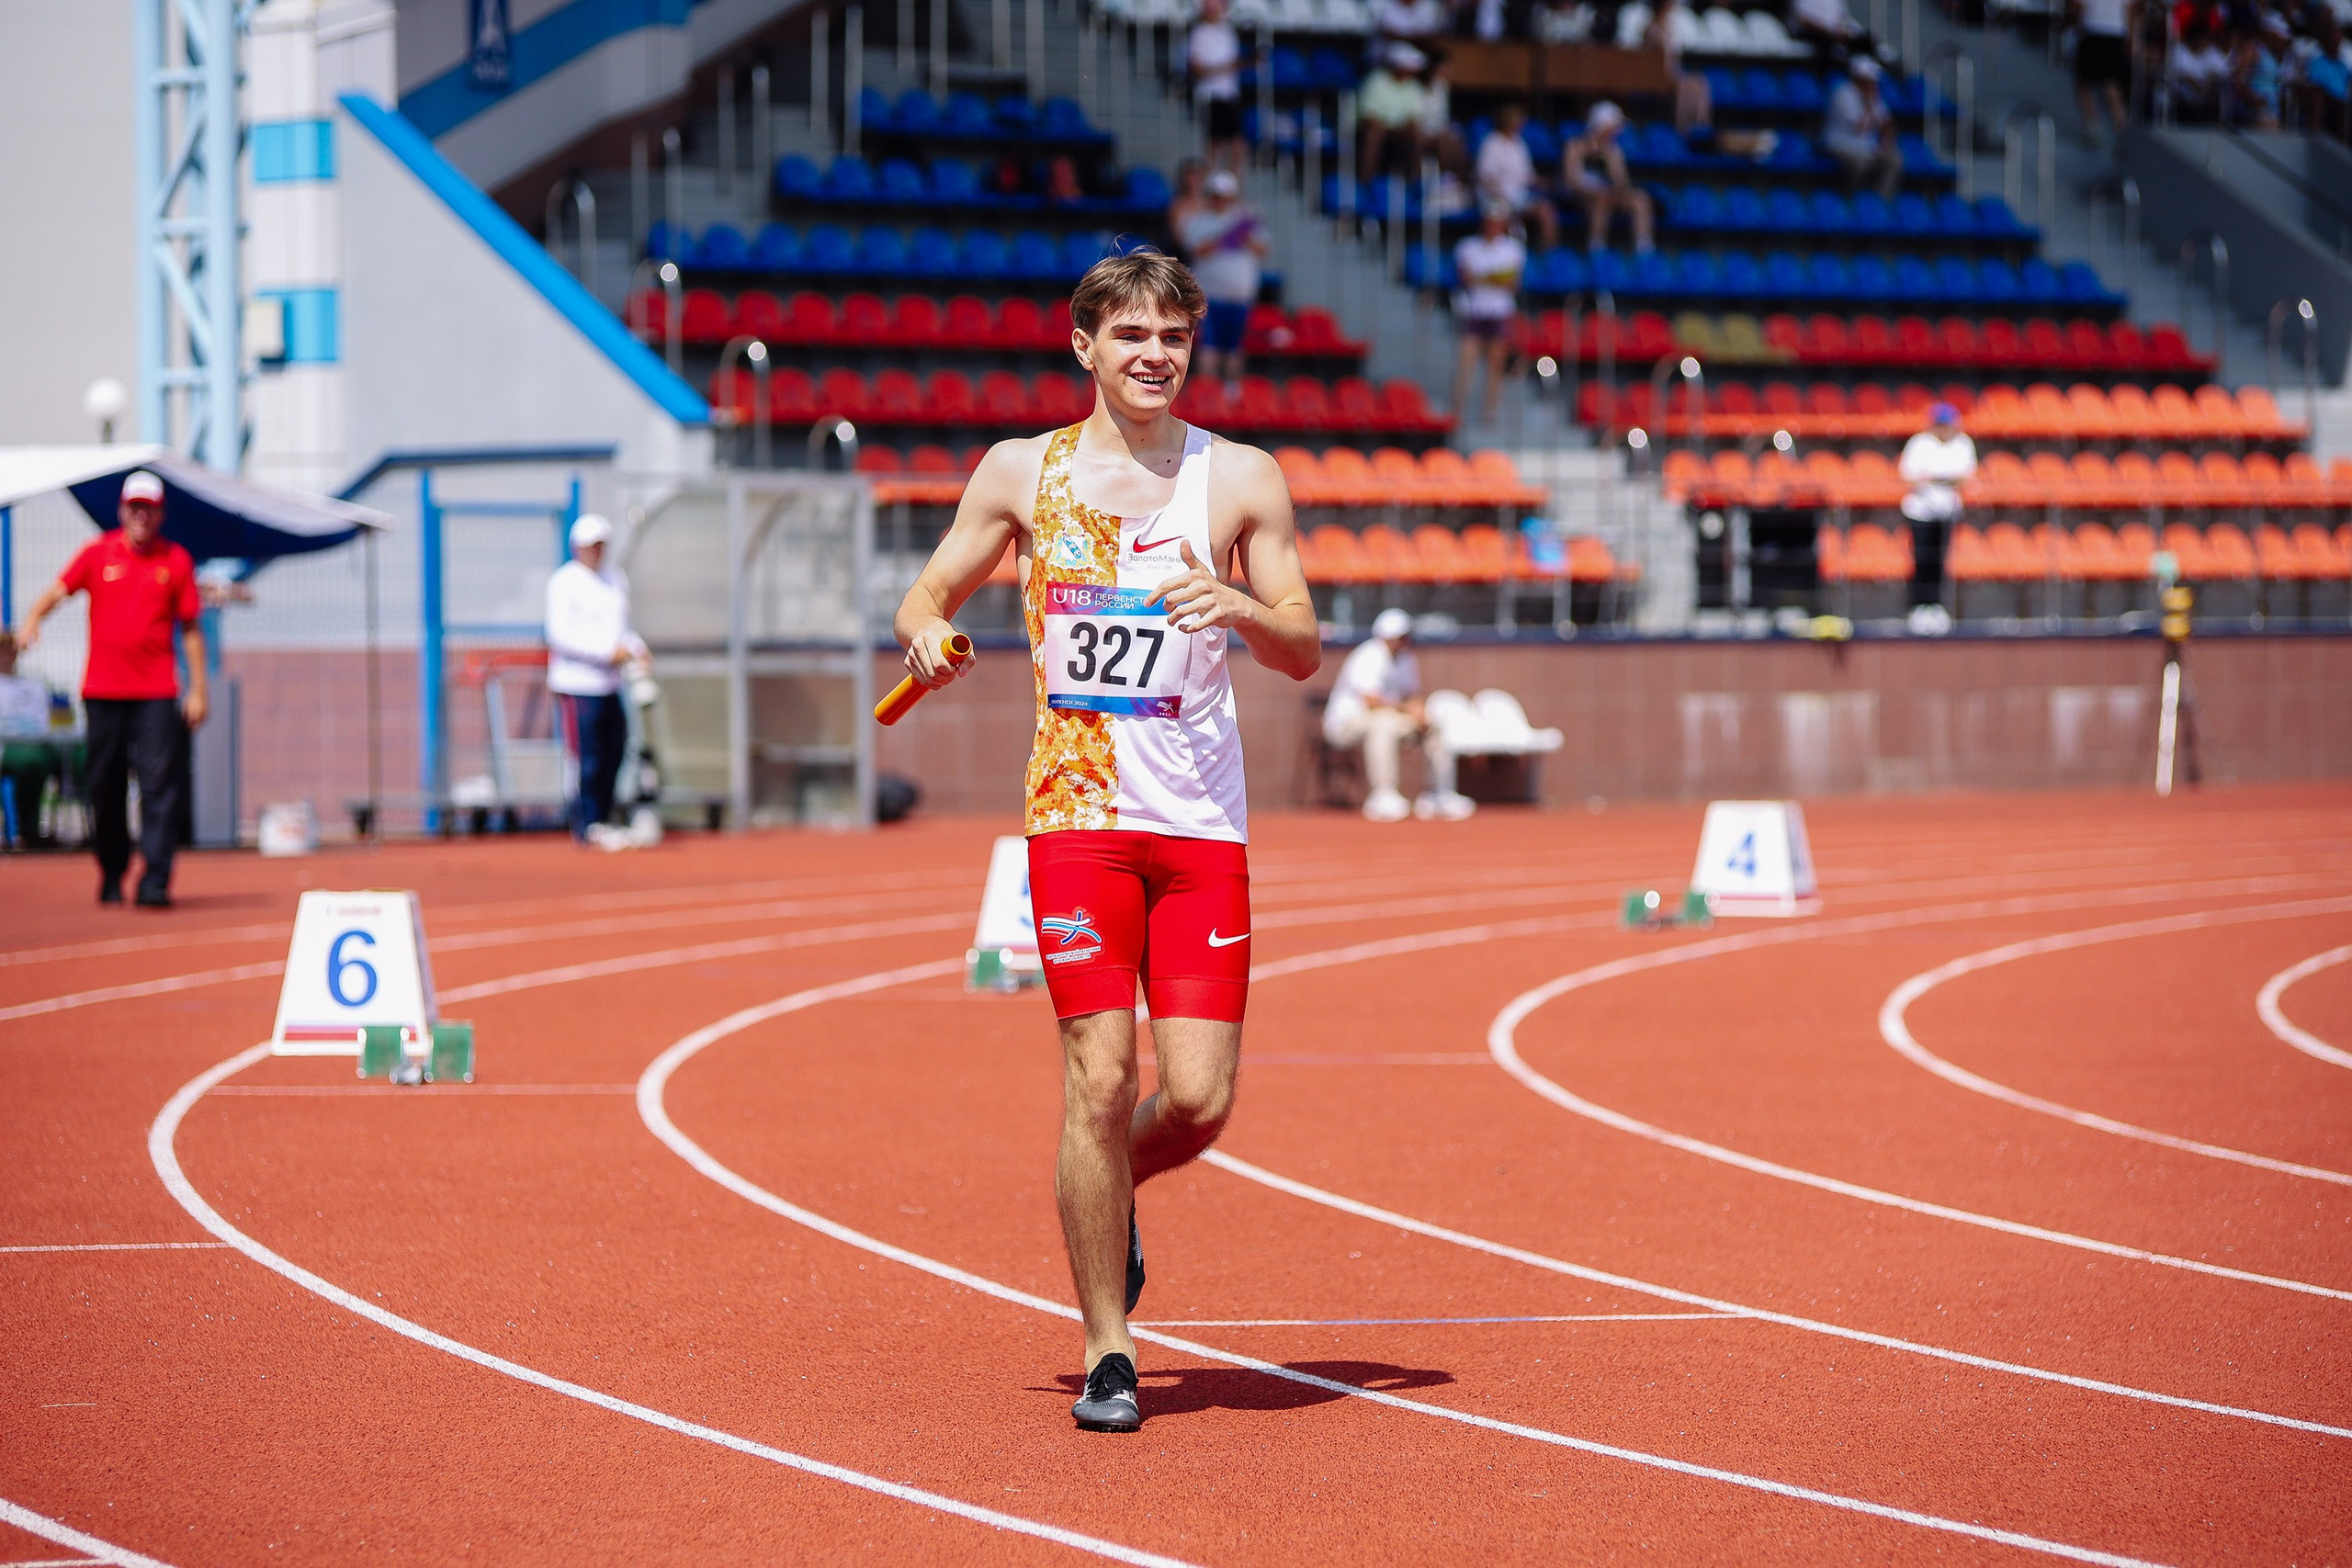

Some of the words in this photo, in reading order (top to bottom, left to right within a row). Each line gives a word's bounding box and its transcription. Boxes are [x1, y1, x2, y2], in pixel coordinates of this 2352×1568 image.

[1052, 588, 1092, 607] U18
[1094, 600, 1135, 610] РОССИИ
[1095, 592, 1146, 604] ПЕРВЕНСТ
[1067, 621, 1165, 689] 327
[1726, 830, 1756, 876] 4
[328, 931, 377, 1007] 6
